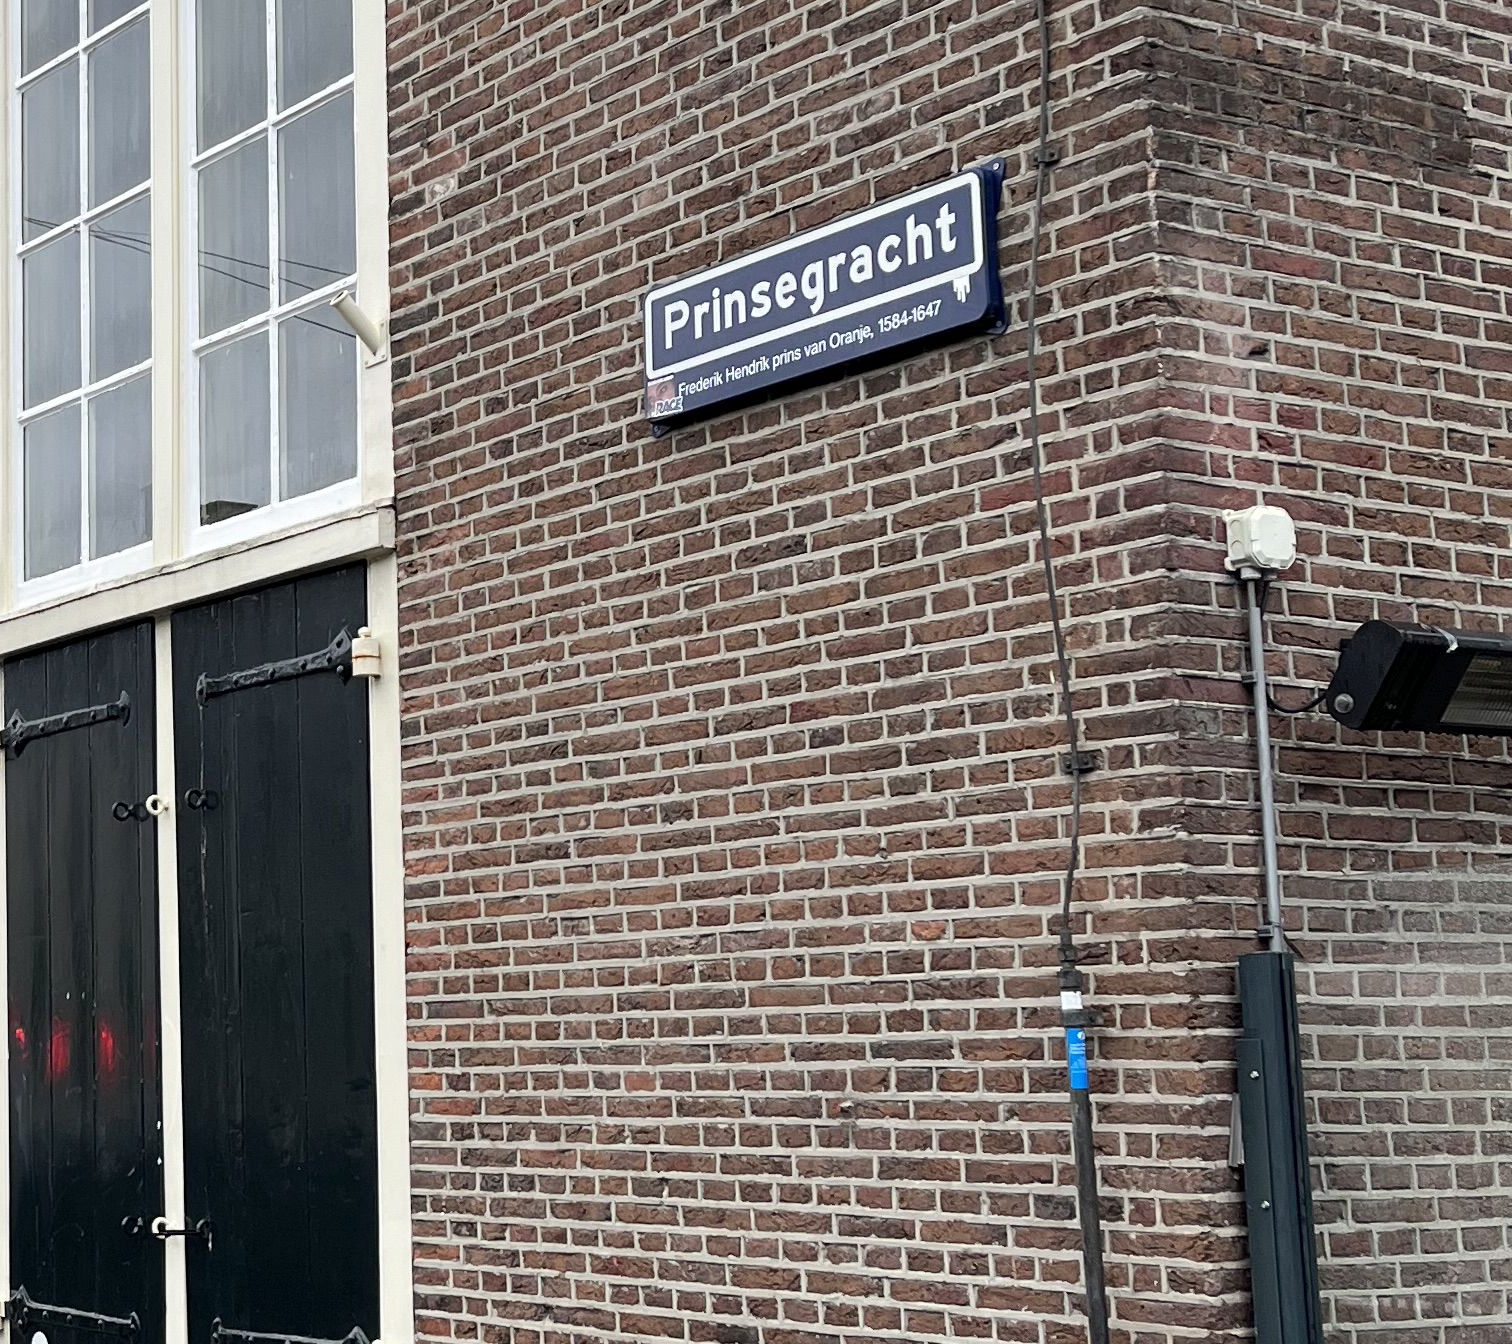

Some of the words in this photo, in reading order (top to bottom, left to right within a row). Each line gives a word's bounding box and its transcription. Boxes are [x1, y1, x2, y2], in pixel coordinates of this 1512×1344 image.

[664, 202, 958, 350] Prinsegracht
[678, 371, 724, 397] Frederik
[725, 357, 771, 384] Hendrik
[772, 347, 802, 372] prins
[803, 339, 827, 358] van
[829, 324, 875, 349] Oranje,
[877, 299, 942, 334] 1584-1647
